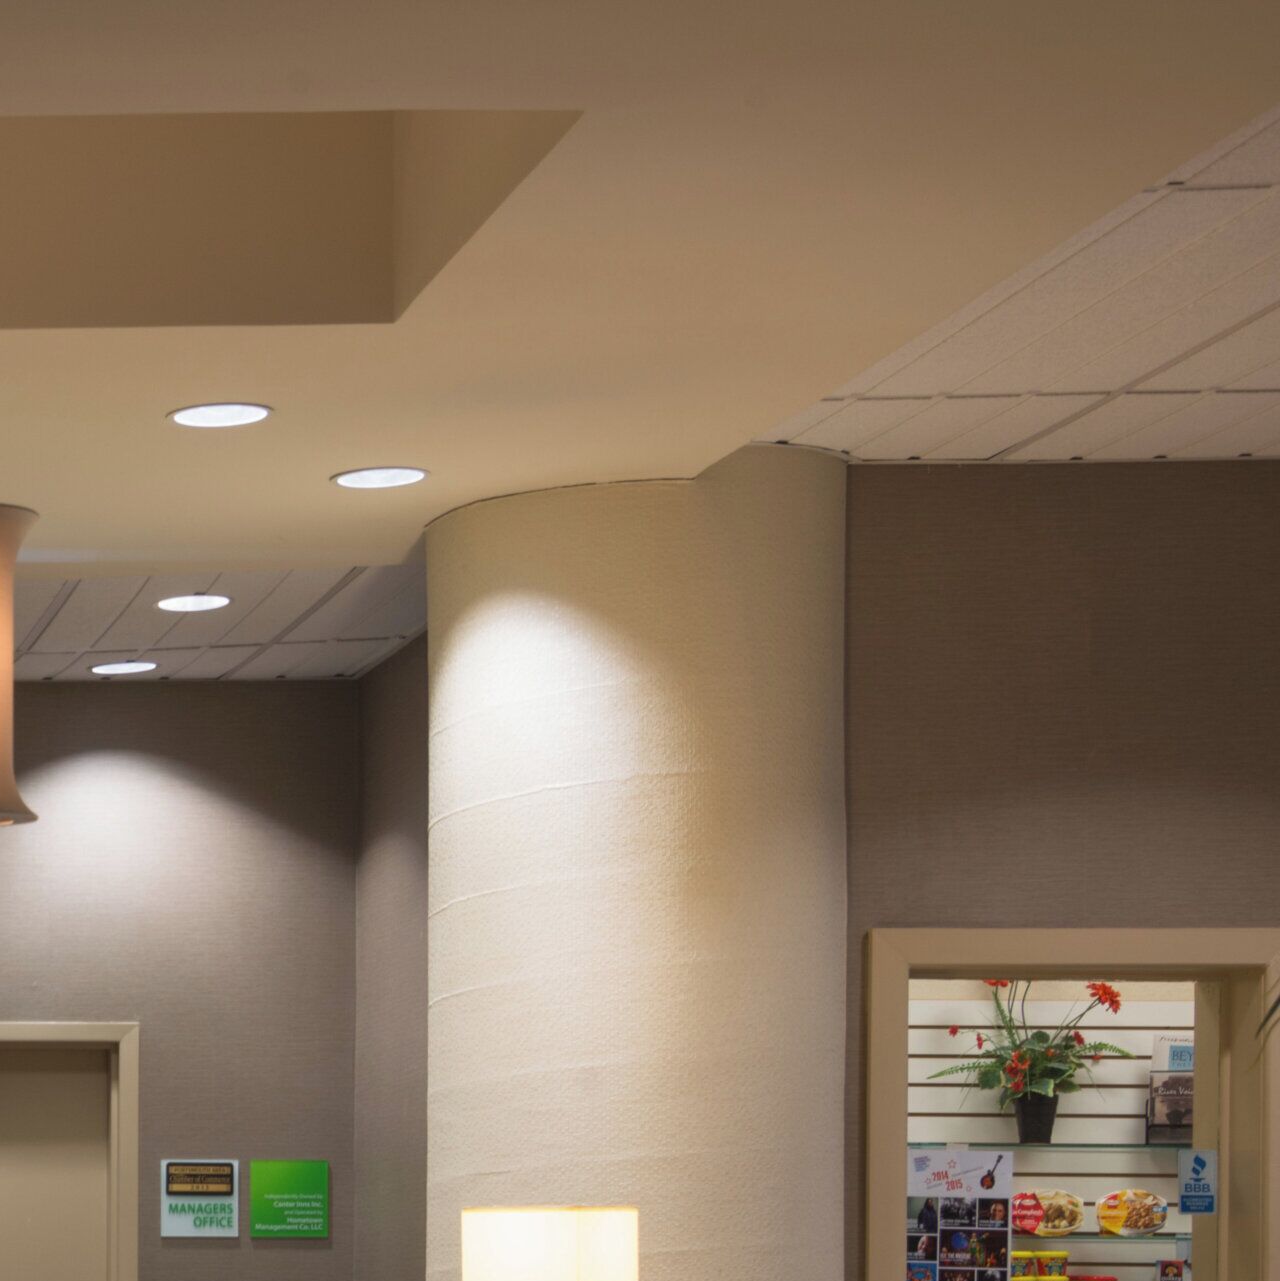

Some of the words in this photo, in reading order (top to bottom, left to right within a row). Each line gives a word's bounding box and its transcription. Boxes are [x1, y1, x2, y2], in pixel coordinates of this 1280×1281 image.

[932, 1170, 949, 1182] 2014
[945, 1179, 963, 1192] 2015
[1184, 1183, 1211, 1193] BBB
[168, 1203, 233, 1214] MANAGERS
[193, 1216, 233, 1228] OFFICE
[255, 1223, 298, 1231] Management
